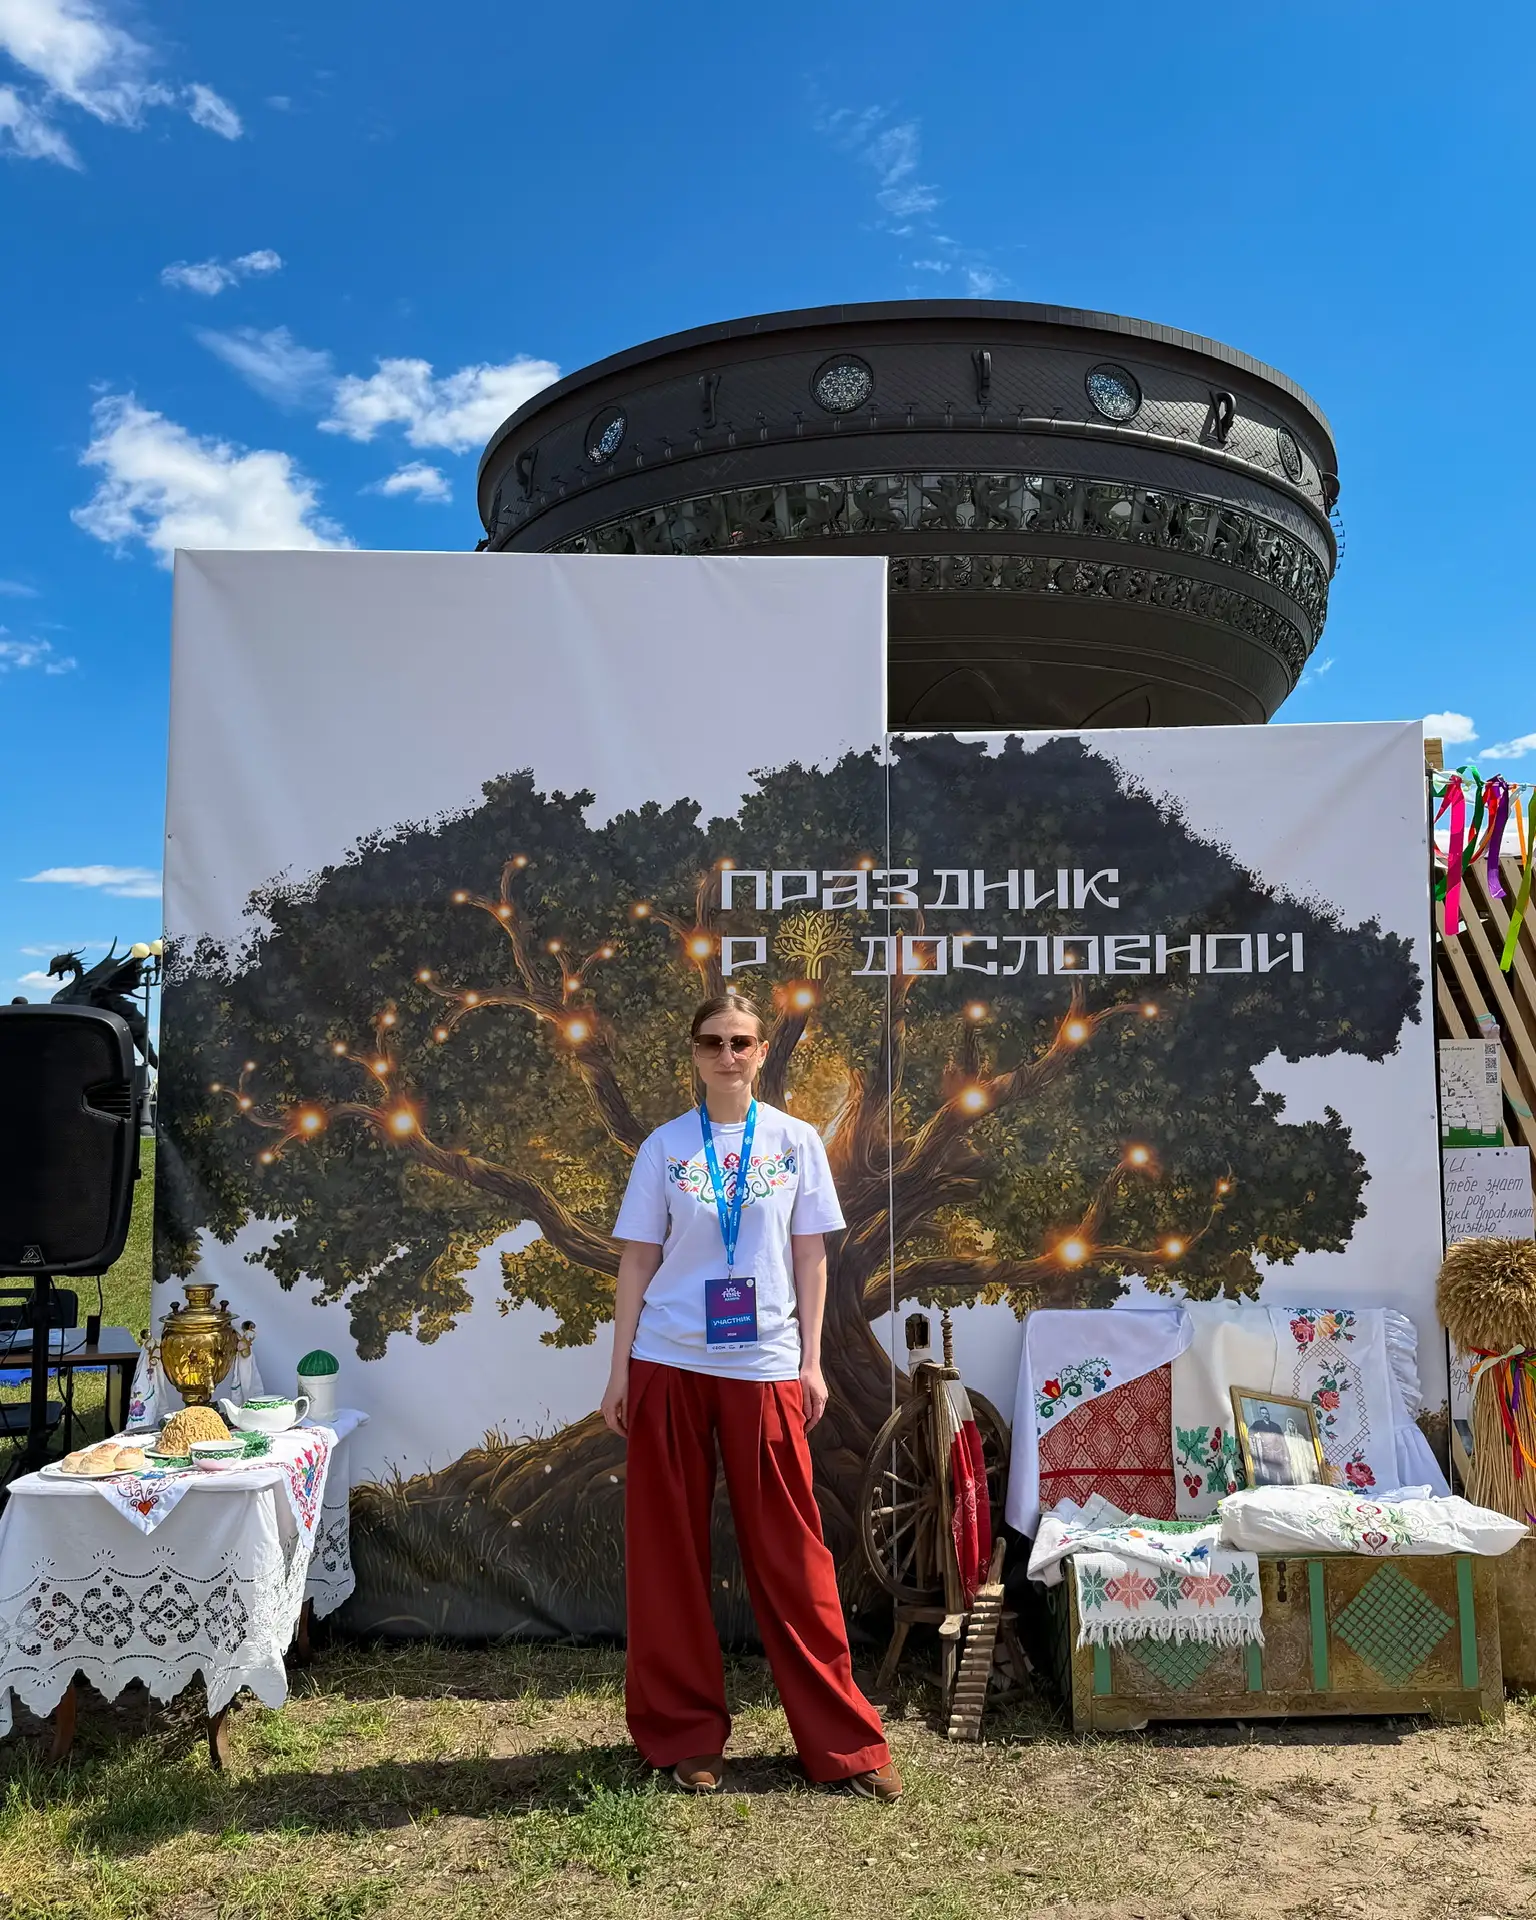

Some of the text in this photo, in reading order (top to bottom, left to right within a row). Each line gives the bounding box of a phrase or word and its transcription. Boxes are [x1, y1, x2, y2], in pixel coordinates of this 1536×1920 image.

[720, 868, 1120, 910] ПРАЗДНИК
[1446, 1175, 1524, 1192] тебе знает
[713, 1315, 751, 1326] УЧАСТНИК
